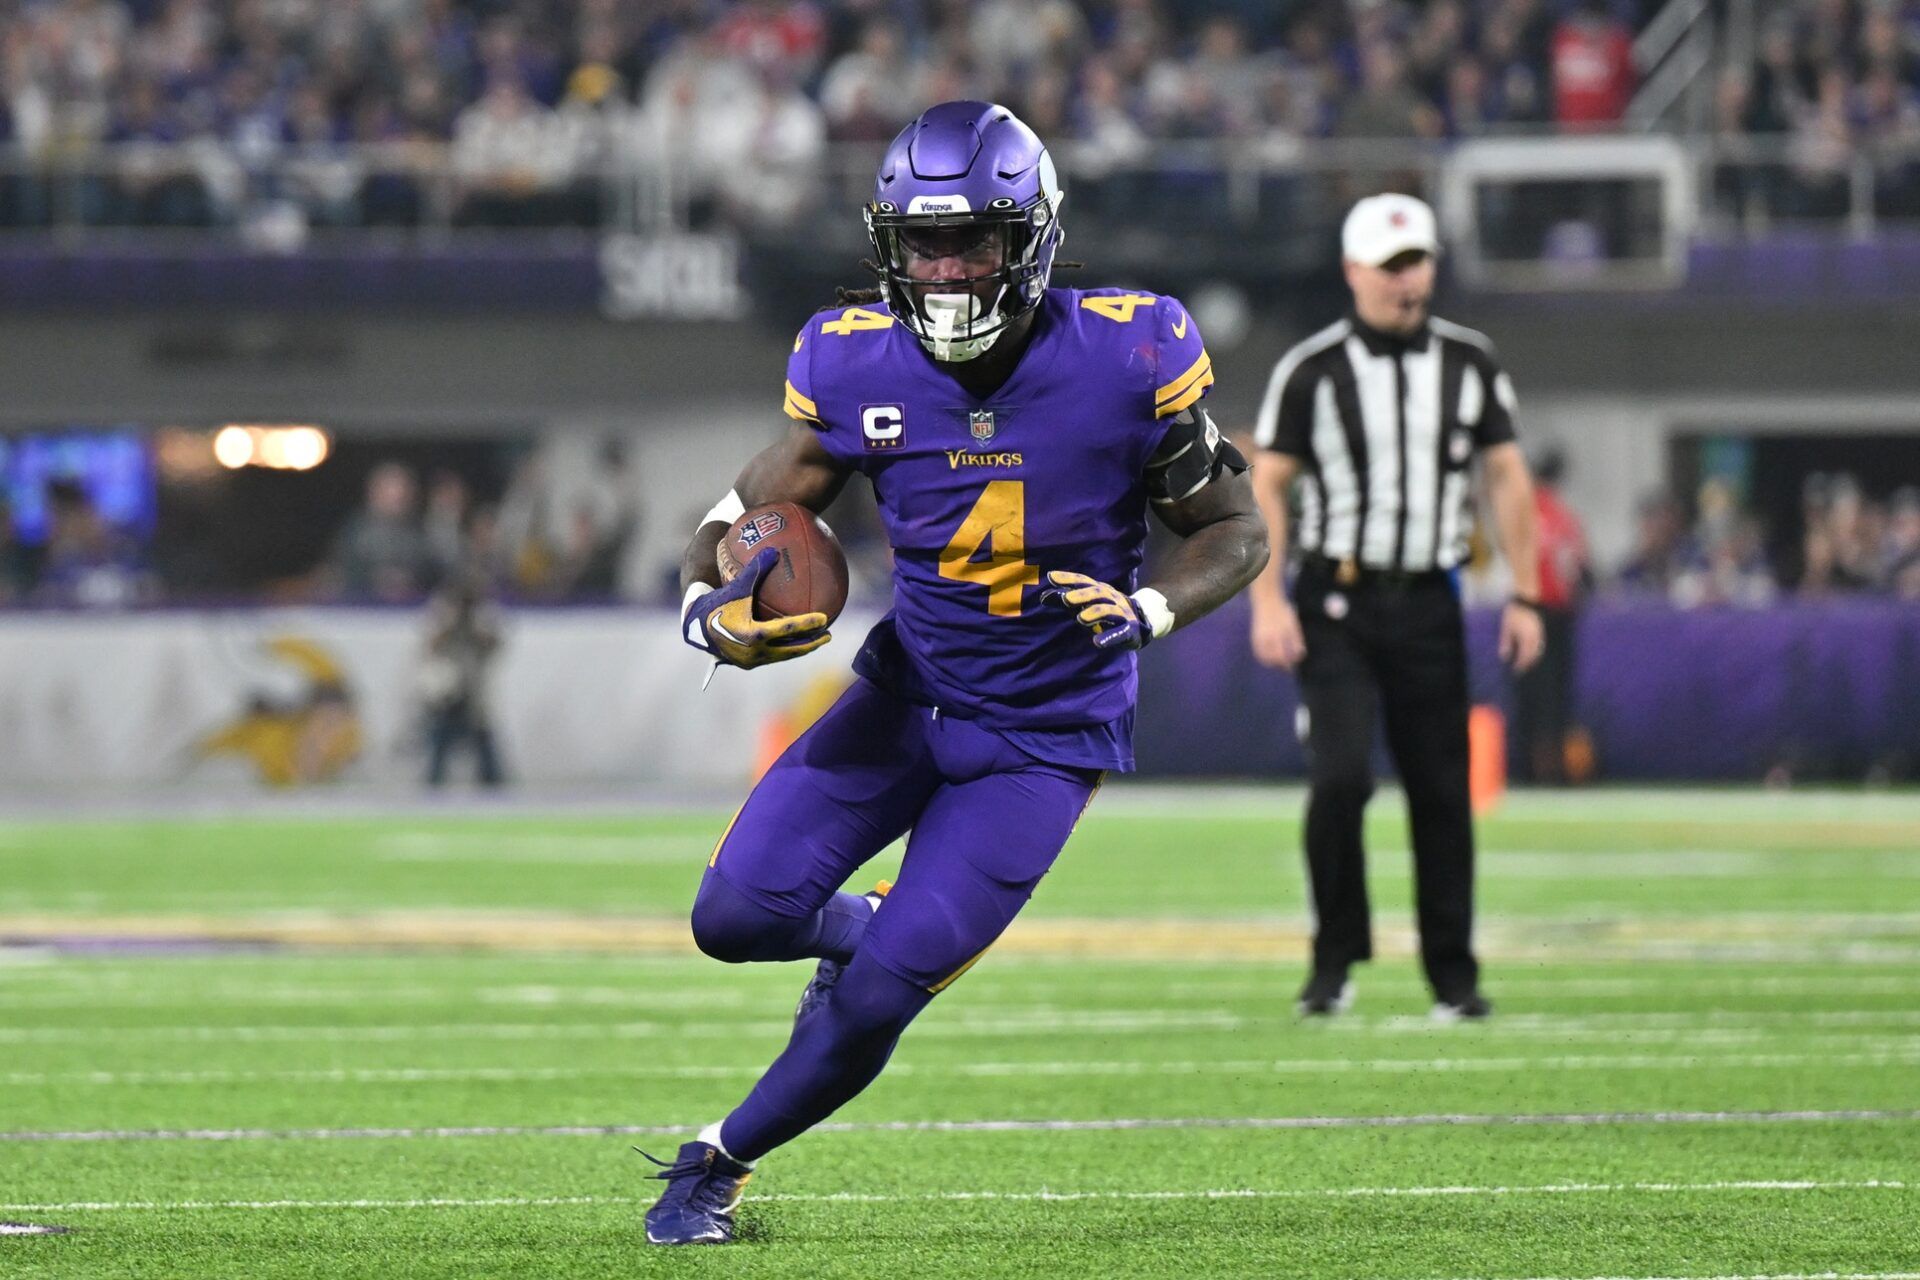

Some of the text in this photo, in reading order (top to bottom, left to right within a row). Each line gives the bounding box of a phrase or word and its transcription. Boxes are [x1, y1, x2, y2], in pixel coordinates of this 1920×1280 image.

[821, 307, 895, 335] 4
[1080, 294, 1156, 323] 4
[862, 406, 902, 440] C
[974, 422, 992, 435] NFL
[945, 448, 1023, 469] VIKINGS
[938, 480, 1040, 617] 4
